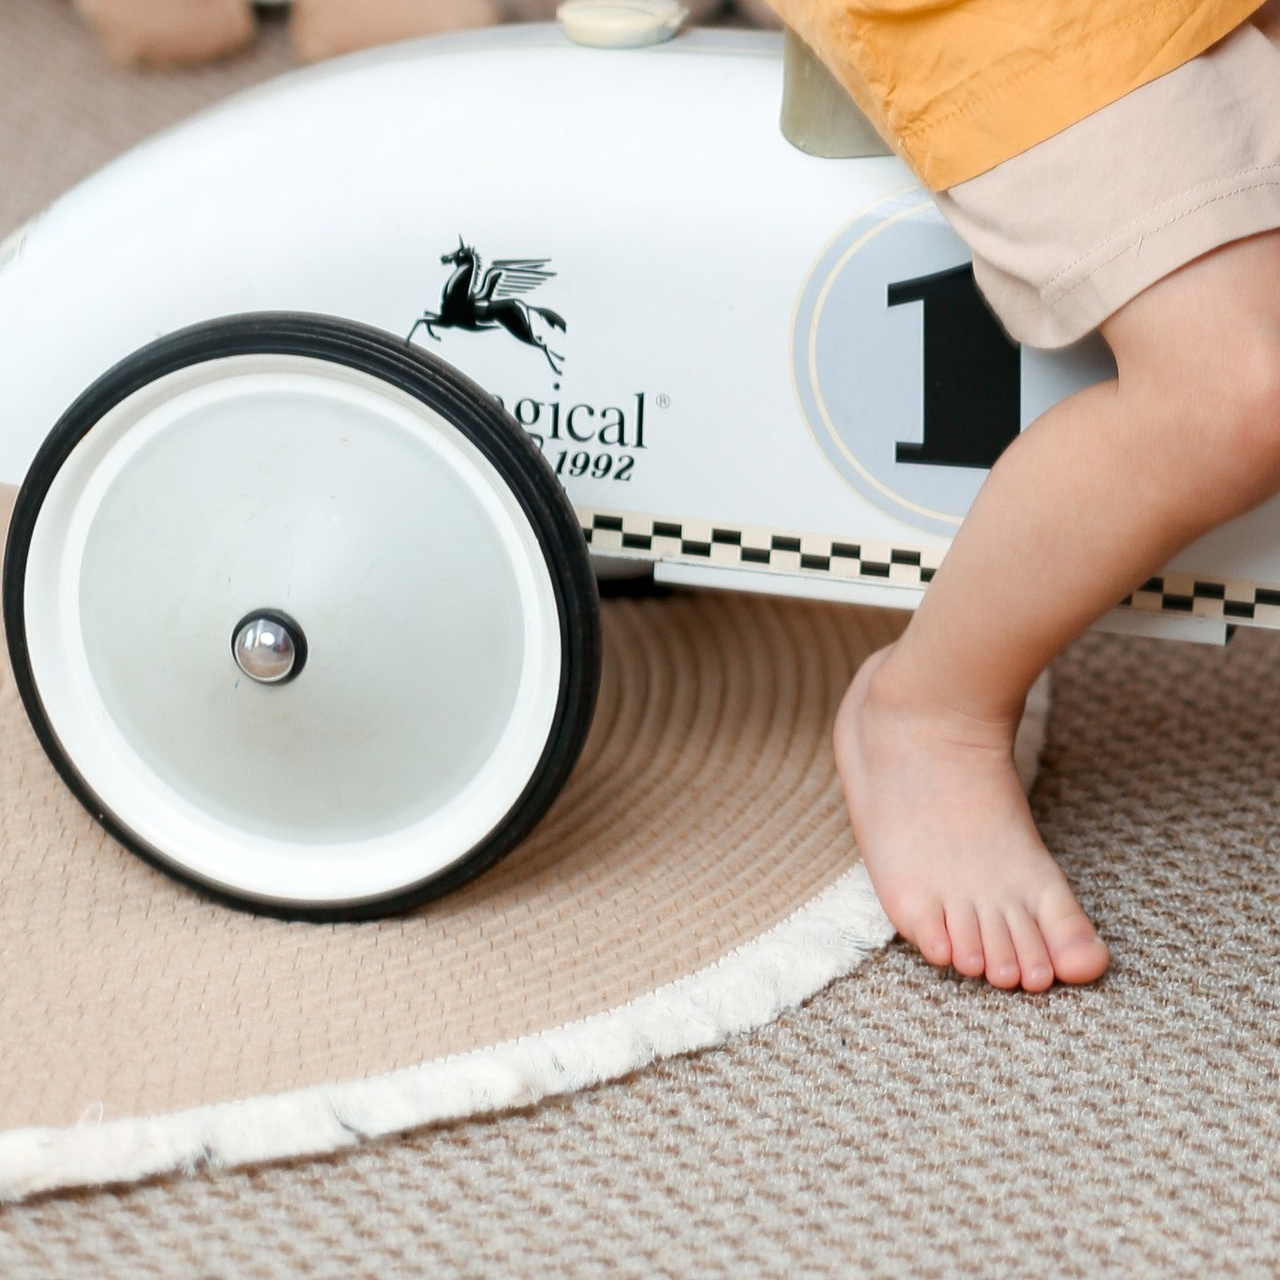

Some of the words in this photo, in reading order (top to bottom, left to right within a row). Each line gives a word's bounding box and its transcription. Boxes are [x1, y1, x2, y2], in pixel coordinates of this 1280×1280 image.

[888, 261, 1020, 469] 1
[494, 382, 648, 451] gical
[556, 450, 635, 481] 1992
